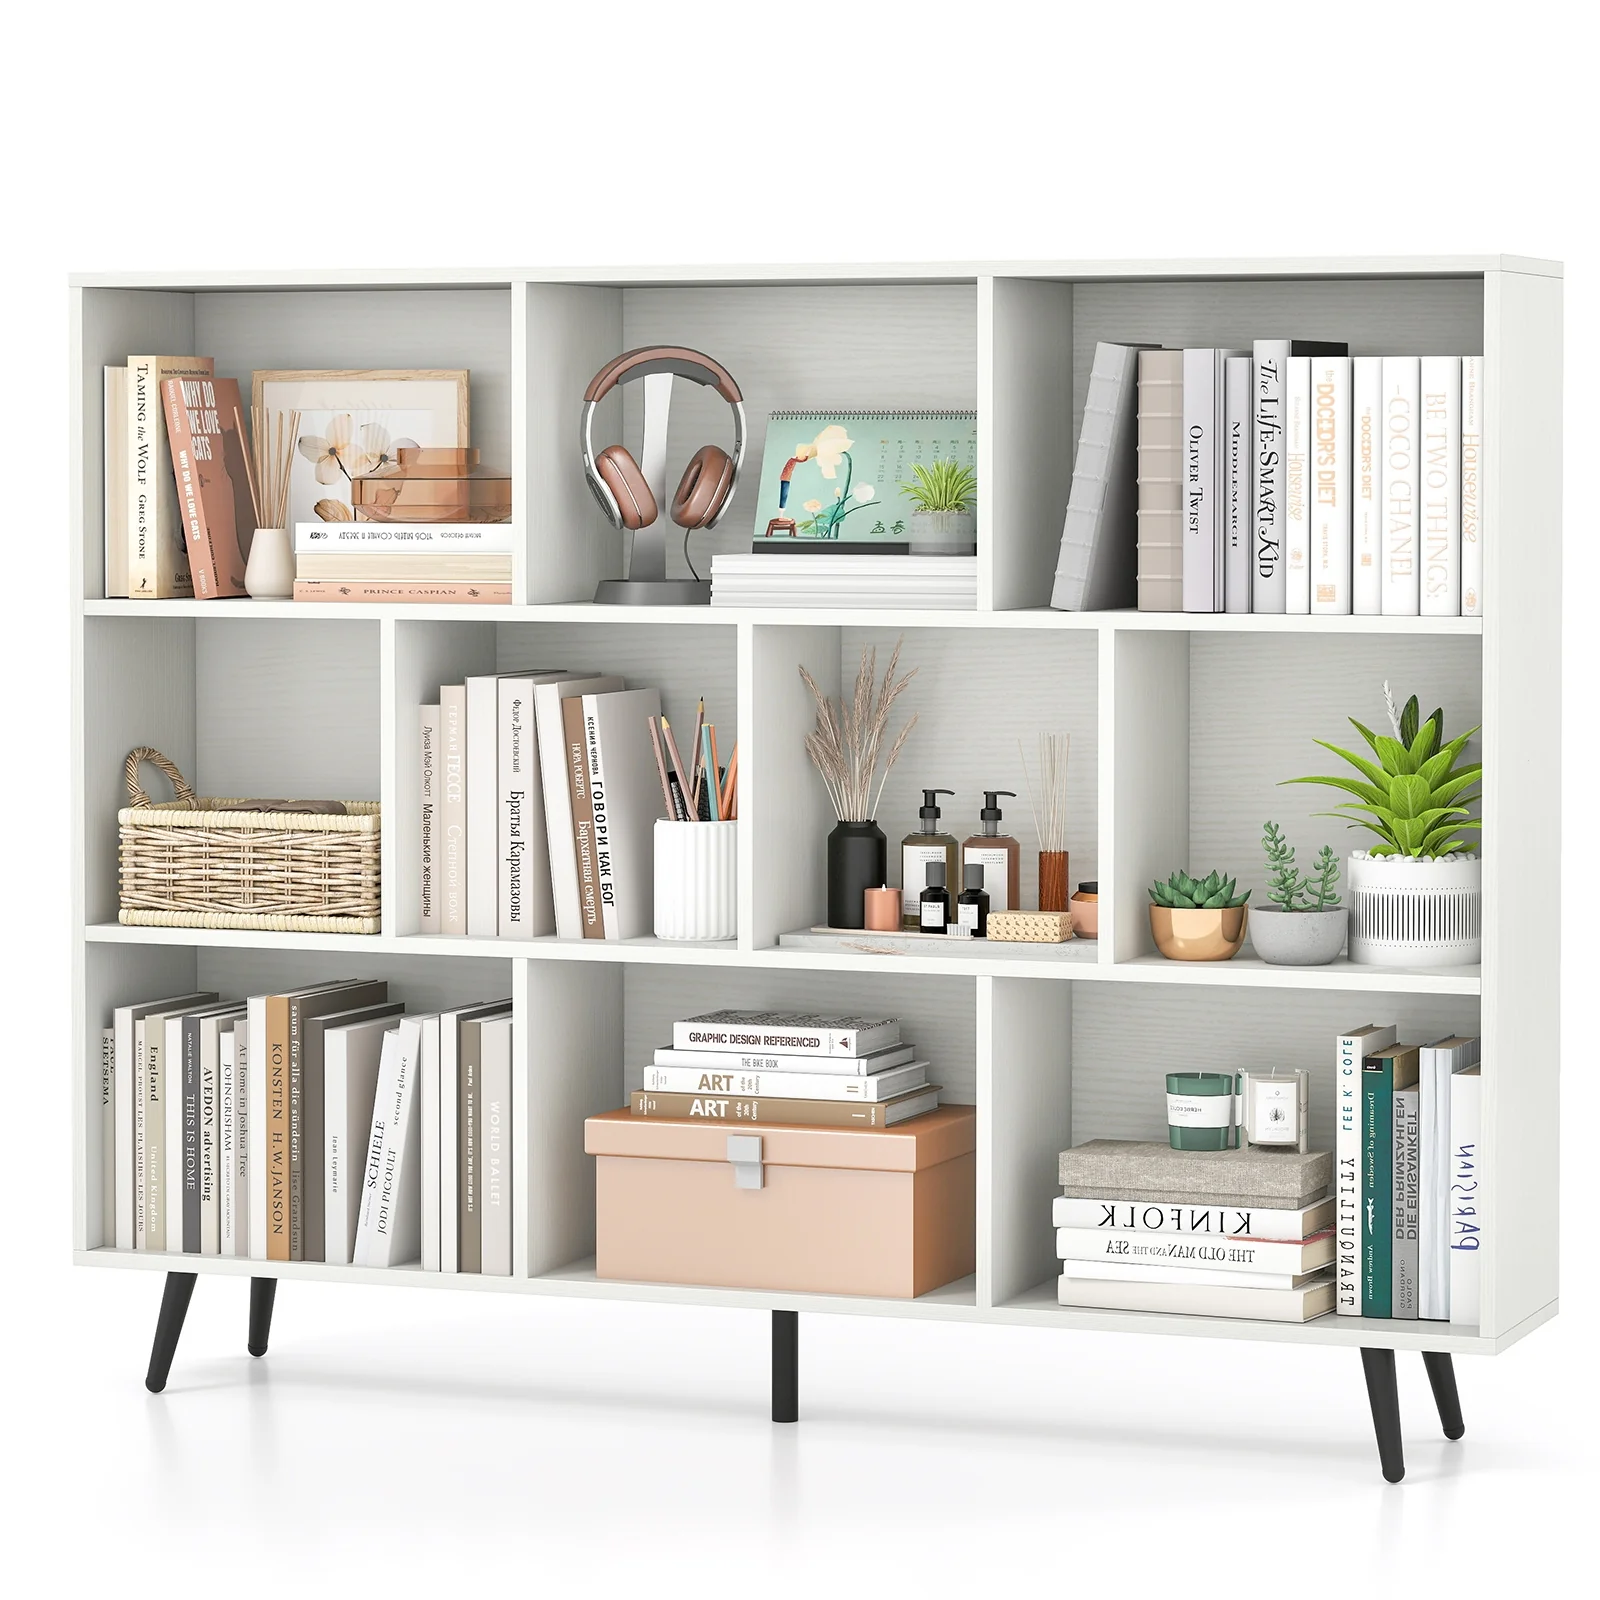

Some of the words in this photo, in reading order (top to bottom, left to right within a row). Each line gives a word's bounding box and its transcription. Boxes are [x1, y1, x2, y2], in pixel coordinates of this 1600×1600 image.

[167, 380, 176, 404] RAQUEL
[1260, 359, 1279, 394] The
[1325, 370, 1334, 382] the
[137, 363, 149, 422] TAMING
[180, 380, 202, 408] WHY
[202, 381, 216, 408] DO
[1425, 392, 1447, 420] BE
[137, 426, 146, 441] the
[171, 403, 181, 433] CORLEONE
[186, 409, 202, 434] WE
[200, 409, 221, 434] LOVE
[137, 443, 149, 485] WOLF
[180, 450, 190, 469] WHY
[191, 436, 213, 460] CATS
[1189, 425, 1204, 482] OLIVER
[1426, 428, 1448, 489] TWO
[181, 469, 191, 482] DO
[184, 484, 194, 497] WE
[1231, 421, 1241, 547] MIDDLEMARCH
[1287, 453, 1306, 521] Housewise
[1317, 470, 1336, 508] DIET
[1361, 475, 1372, 500] DIET
[1462, 433, 1480, 543] Housewise
[138, 494, 147, 523] GREG
[186, 498, 197, 518] LOVE
[1189, 487, 1204, 534] TWIST
[138, 526, 147, 559] STONE
[190, 520, 201, 541] CATS
[1389, 480, 1412, 583] CHANEL
[1426, 497, 1448, 598] THINGS:
[199, 574, 208, 594] BOOKS
[422, 726, 433, 750] Луиза
[449, 705, 457, 751] ГЕРМАН
[587, 716, 597, 746] КСЕНИЯ
[423, 751, 433, 768] Мэй
[571, 743, 582, 763] НОРА
[590, 746, 599, 776] ЧЕРНОВА
[423, 769, 433, 797] Олкотт
[447, 755, 461, 803] ГЕССЕ
[574, 765, 586, 800] РОБЕРТС
[506, 791, 525, 837] Братья
[592, 781, 609, 845] ГОВОРИ
[422, 803, 433, 864] Маленькие
[447, 825, 462, 887] Степной
[576, 820, 593, 883] Бархатная
[598, 851, 612, 877] КАК
[422, 865, 431, 918] женщины
[506, 841, 525, 923] Карамазовы
[601, 883, 615, 907] БОГ
[448, 892, 458, 922] волк
[583, 885, 597, 925] смерть
[239, 1044, 247, 1057] At
[291, 1040, 300, 1058] für
[689, 1032, 728, 1044] GRAPHIC
[729, 1033, 762, 1046] DESIGN
[763, 1035, 820, 1048] REFERENCED
[148, 1046, 159, 1102] England
[239, 1062, 247, 1094] Home
[291, 1061, 300, 1083] alla
[397, 1056, 407, 1089] glance
[741, 1057, 751, 1067] THE
[752, 1058, 764, 1068] BIKE
[765, 1059, 779, 1068] BOOK
[203, 1067, 213, 1127] AVEDON
[271, 1043, 283, 1120] KONSTEN
[291, 1086, 300, 1105] die
[698, 1073, 734, 1091] ART
[186, 1093, 195, 1126] THIS
[239, 1097, 248, 1108] in
[393, 1091, 403, 1126] second
[689, 1098, 730, 1118] ART
[735, 1109, 742, 1118] of
[751, 1100, 759, 1121] Century
[186, 1130, 195, 1143] IS
[238, 1110, 248, 1149] Joshua
[291, 1109, 300, 1162] sünderin
[490, 1101, 501, 1152] WORLD
[186, 1147, 195, 1190] HOME
[202, 1130, 213, 1201] advertising
[239, 1153, 248, 1178] Tree
[367, 1121, 385, 1189] SCHIELE
[292, 1170, 300, 1191] lise
[331, 1156, 339, 1193] Leymarie
[381, 1147, 396, 1203] PICOULT
[490, 1158, 500, 1206] BALLET
[149, 1185, 157, 1232] Kingdom
[291, 1195, 300, 1251] Grandsun
[377, 1205, 389, 1235] JODI
